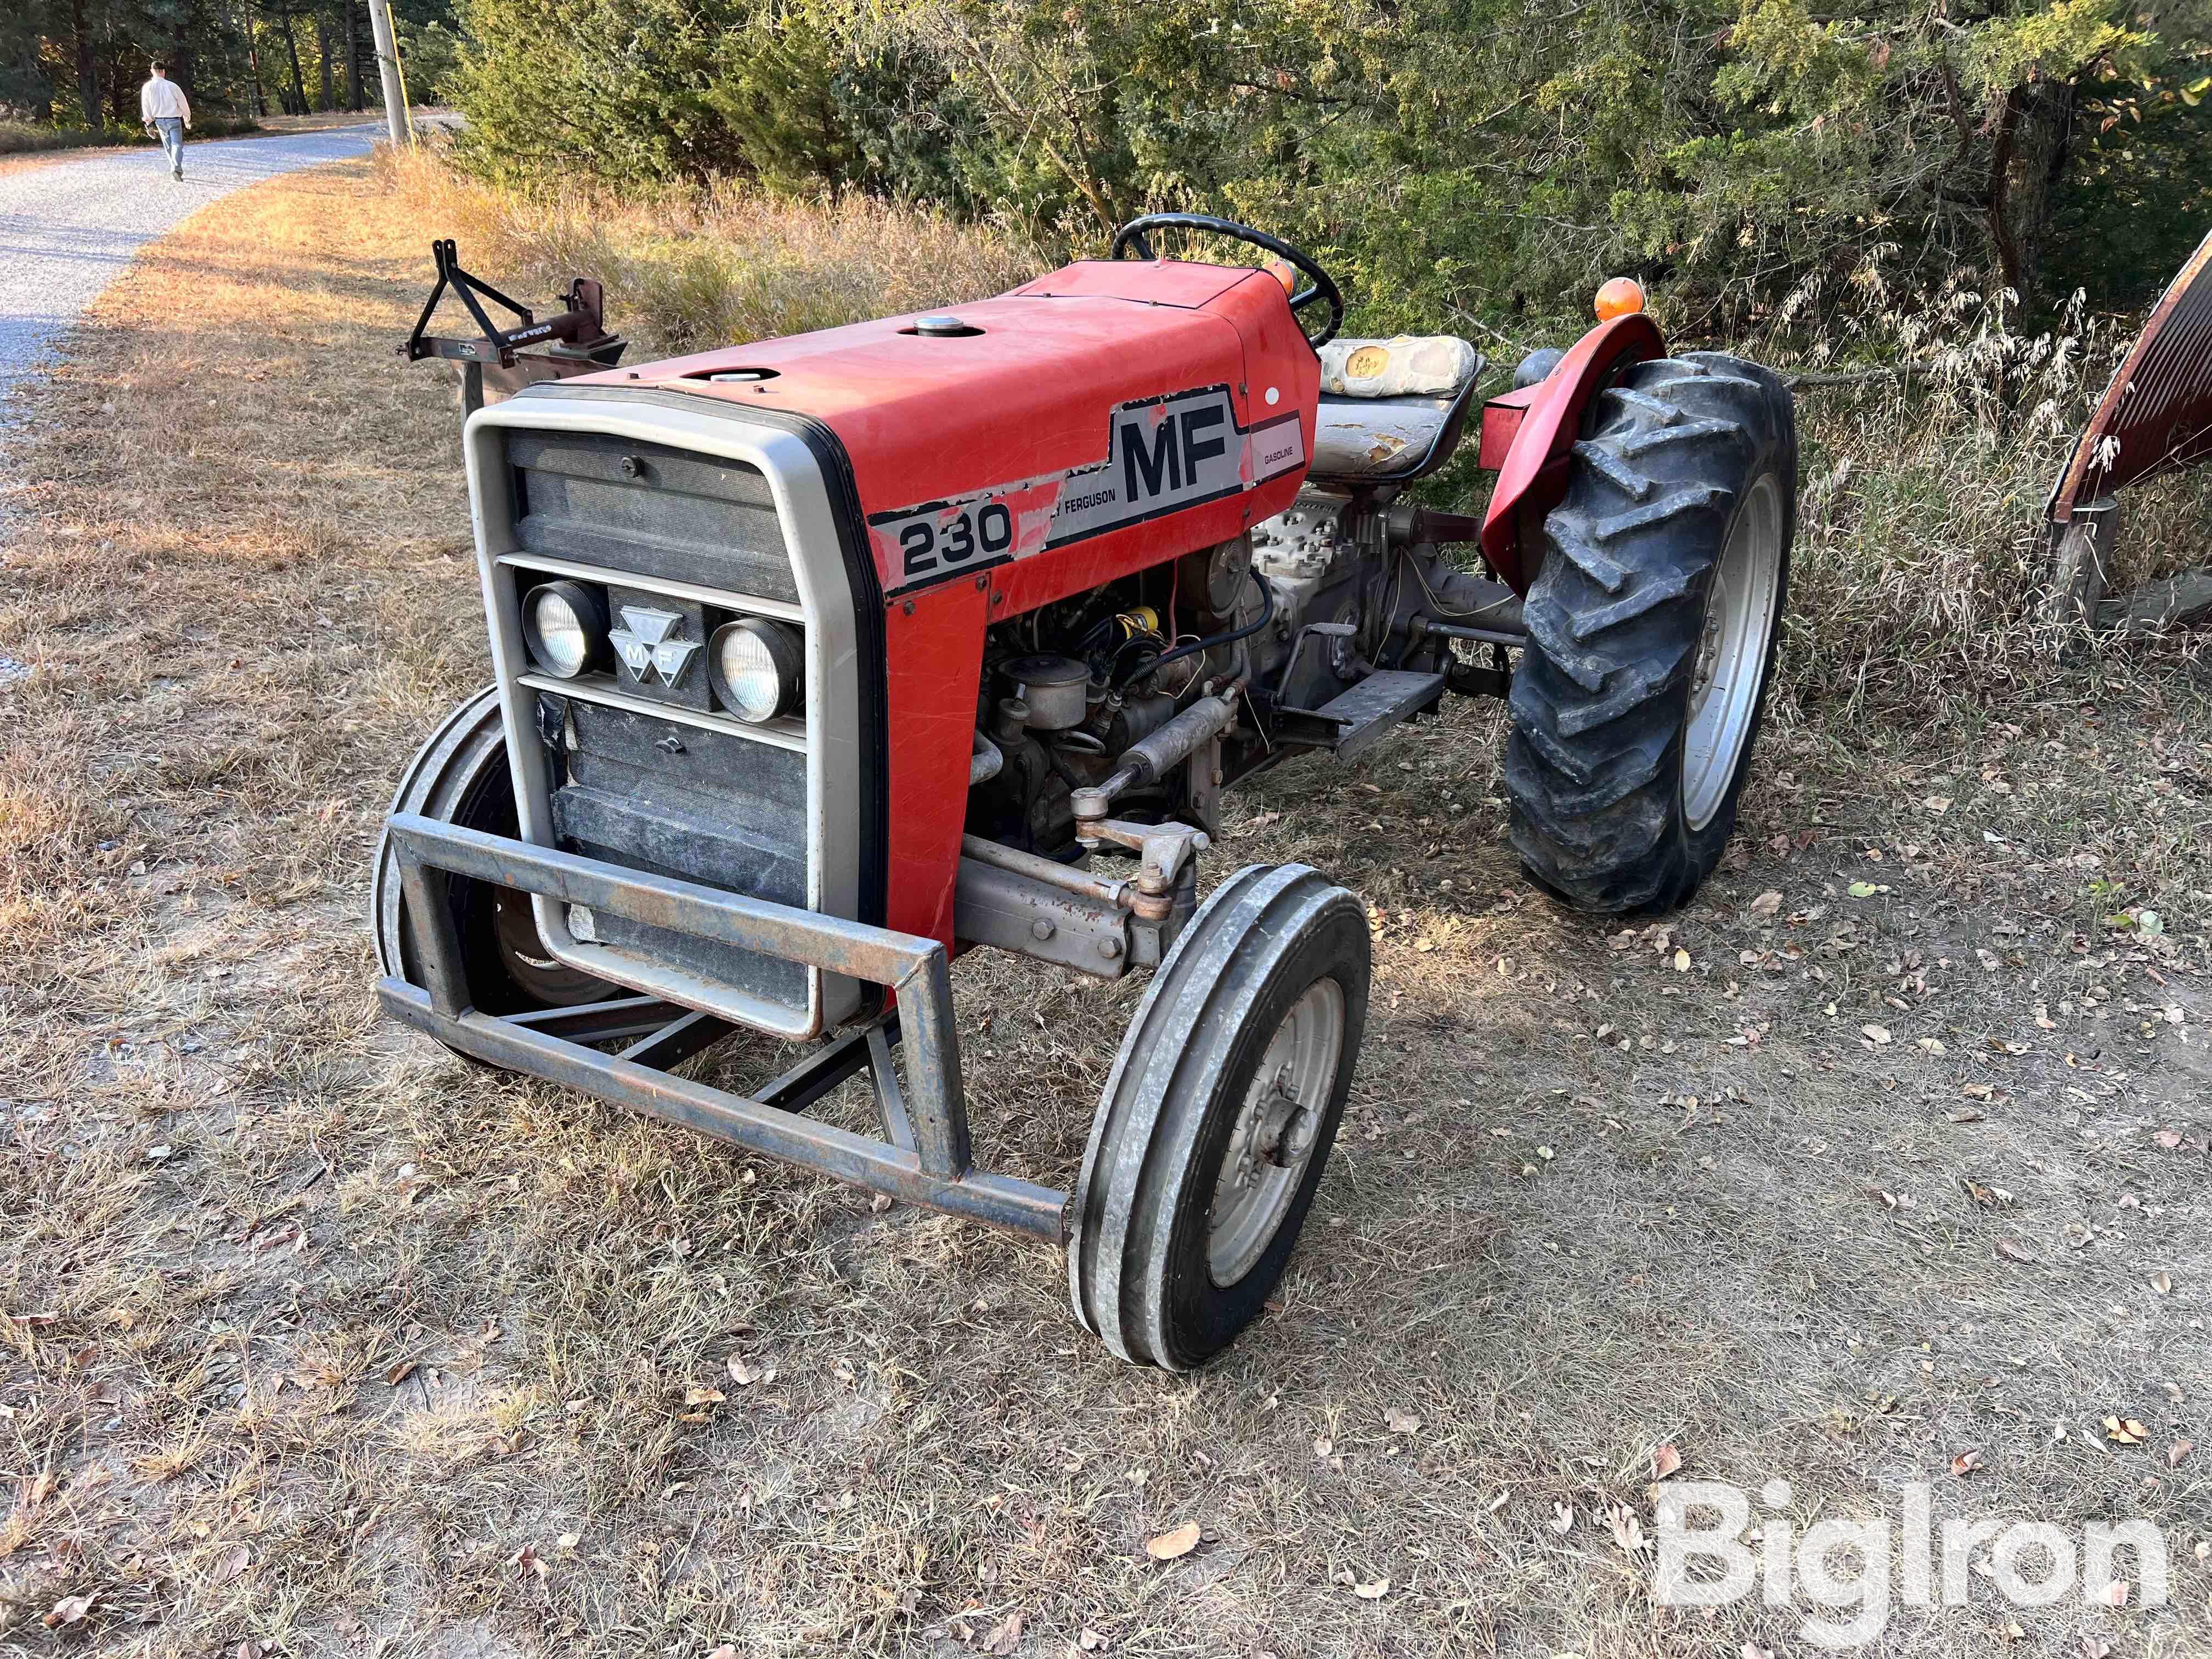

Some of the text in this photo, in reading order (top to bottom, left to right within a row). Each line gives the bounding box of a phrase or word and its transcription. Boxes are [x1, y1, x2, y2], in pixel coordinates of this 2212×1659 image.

[1120, 405, 1224, 503] MF
[1265, 447, 1293, 464] GASOLINE
[1065, 489, 1115, 514] FERGUSON
[900, 504, 1012, 575] 230
